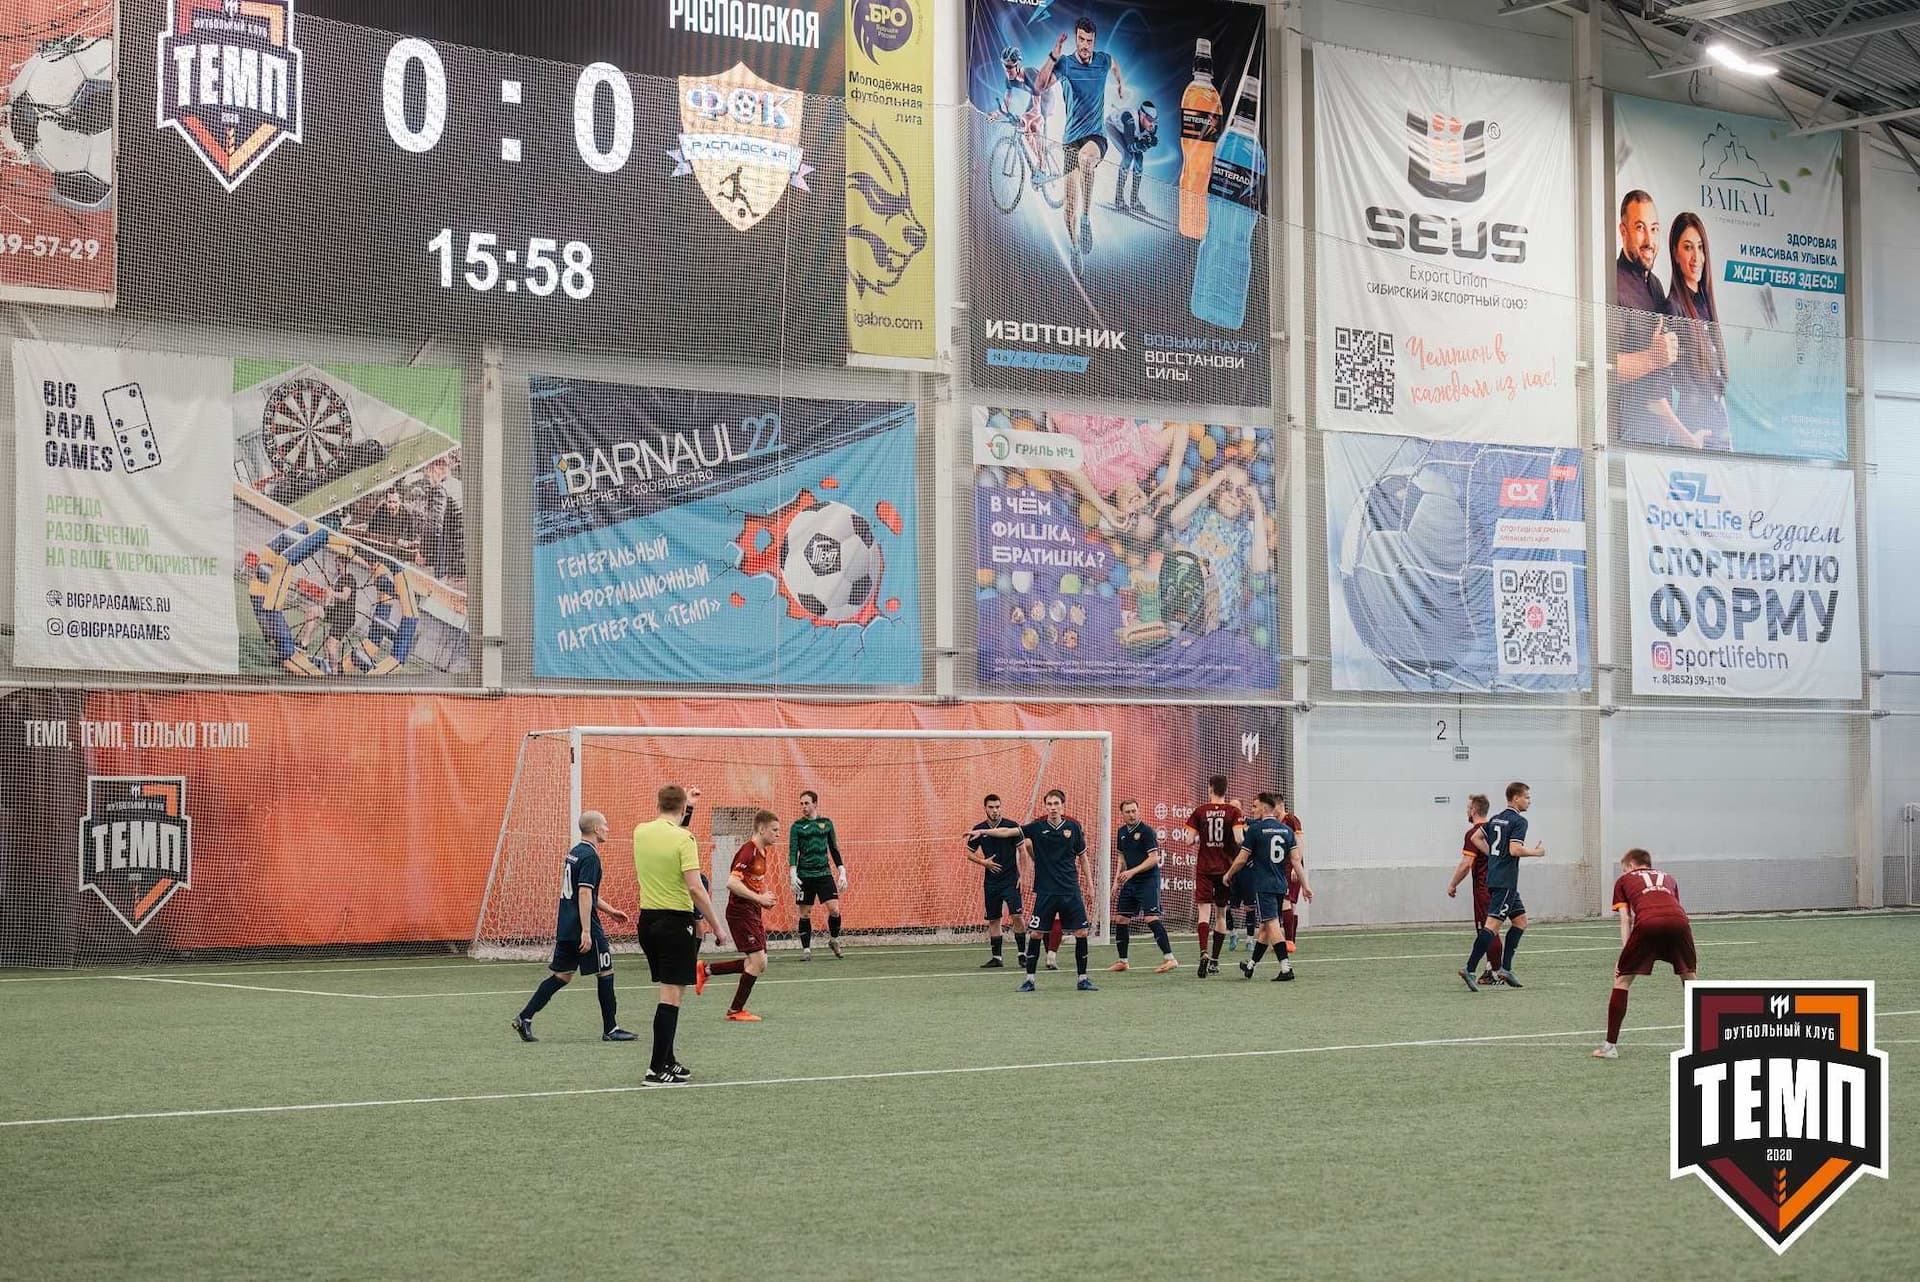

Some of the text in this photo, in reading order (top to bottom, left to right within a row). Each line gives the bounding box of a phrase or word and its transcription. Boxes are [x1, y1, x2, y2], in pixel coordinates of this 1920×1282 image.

[669, 0, 820, 49] РАСПАДСКАЯ
[173, 44, 288, 120] ТЕМП
[848, 70, 923, 94] Молодёжная
[382, 37, 447, 153] 0
[573, 61, 635, 174] 0
[850, 87, 923, 109] футбольная
[895, 113, 922, 126] лига
[1700, 184, 1775, 218] BAIKAL
[1364, 206, 1529, 264] SEUS
[1786, 232, 1838, 250] ЗДОРОВАЯ
[428, 228, 595, 300] 15:58
[1740, 243, 1838, 267] И КРАСИВАЯ УЛЫБКА
[1409, 264, 1488, 289] Export Union
[1732, 264, 1838, 289] ЖДЕТ ТЕБЯ ЗДЕСЬ!
[1366, 281, 1428, 301] СИБИРСКИЙ
[1430, 289, 1500, 308] ЭКСПОРТНЫЙ
[985, 318, 1128, 351] ИЗОТОНИК
[1145, 350, 1245, 369] ВОССТАНОВИ
[1145, 366, 1193, 381] СИЛЫ.
[43, 380, 77, 409] BIG
[44, 411, 96, 442] PAPA
[44, 441, 113, 473] GAMES
[1015, 443, 1054, 457] ГРИЛЬ
[45, 494, 103, 519] АРЕНДА
[990, 490, 1051, 517] В ЧЁМ
[45, 519, 150, 548] РАЗВЛЕЧЕНИЙ
[990, 521, 1077, 546] ФИШКА,
[1749, 509, 1846, 551] Создаем
[45, 548, 219, 577] НА ВАШЕ МЕРОПРИЯТИЕ
[556, 533, 671, 580] ГЕНЕРАЛЬНЫЙ
[992, 546, 1106, 569] БРАТИШКА?
[1648, 544, 1840, 584] СПОРТИВНУЮ
[66, 591, 171, 614] BIGPAPAGAMES.RU
[557, 562, 711, 619] ИНФОРМАЦИОННЫЙ
[1649, 583, 1839, 644] ФОРМУ
[66, 620, 171, 641] @BIGPAPAGAMES
[557, 618, 630, 653] ПАРТНЕР
[633, 615, 660, 637] ФК
[1674, 644, 1790, 673] sportlifebrn
[24, 720, 249, 751] ТЕМП, ТЕМП, ТОЛЬКО ТЕМП!
[1436, 720, 1447, 741] 2
[1206, 817, 1225, 843] 18
[1491, 825, 1501, 856] 2
[91, 820, 181, 874] ТЕМП
[1270, 835, 1285, 864] 6
[1500, 903, 1510, 917] 2
[599, 951, 612, 969] 10
